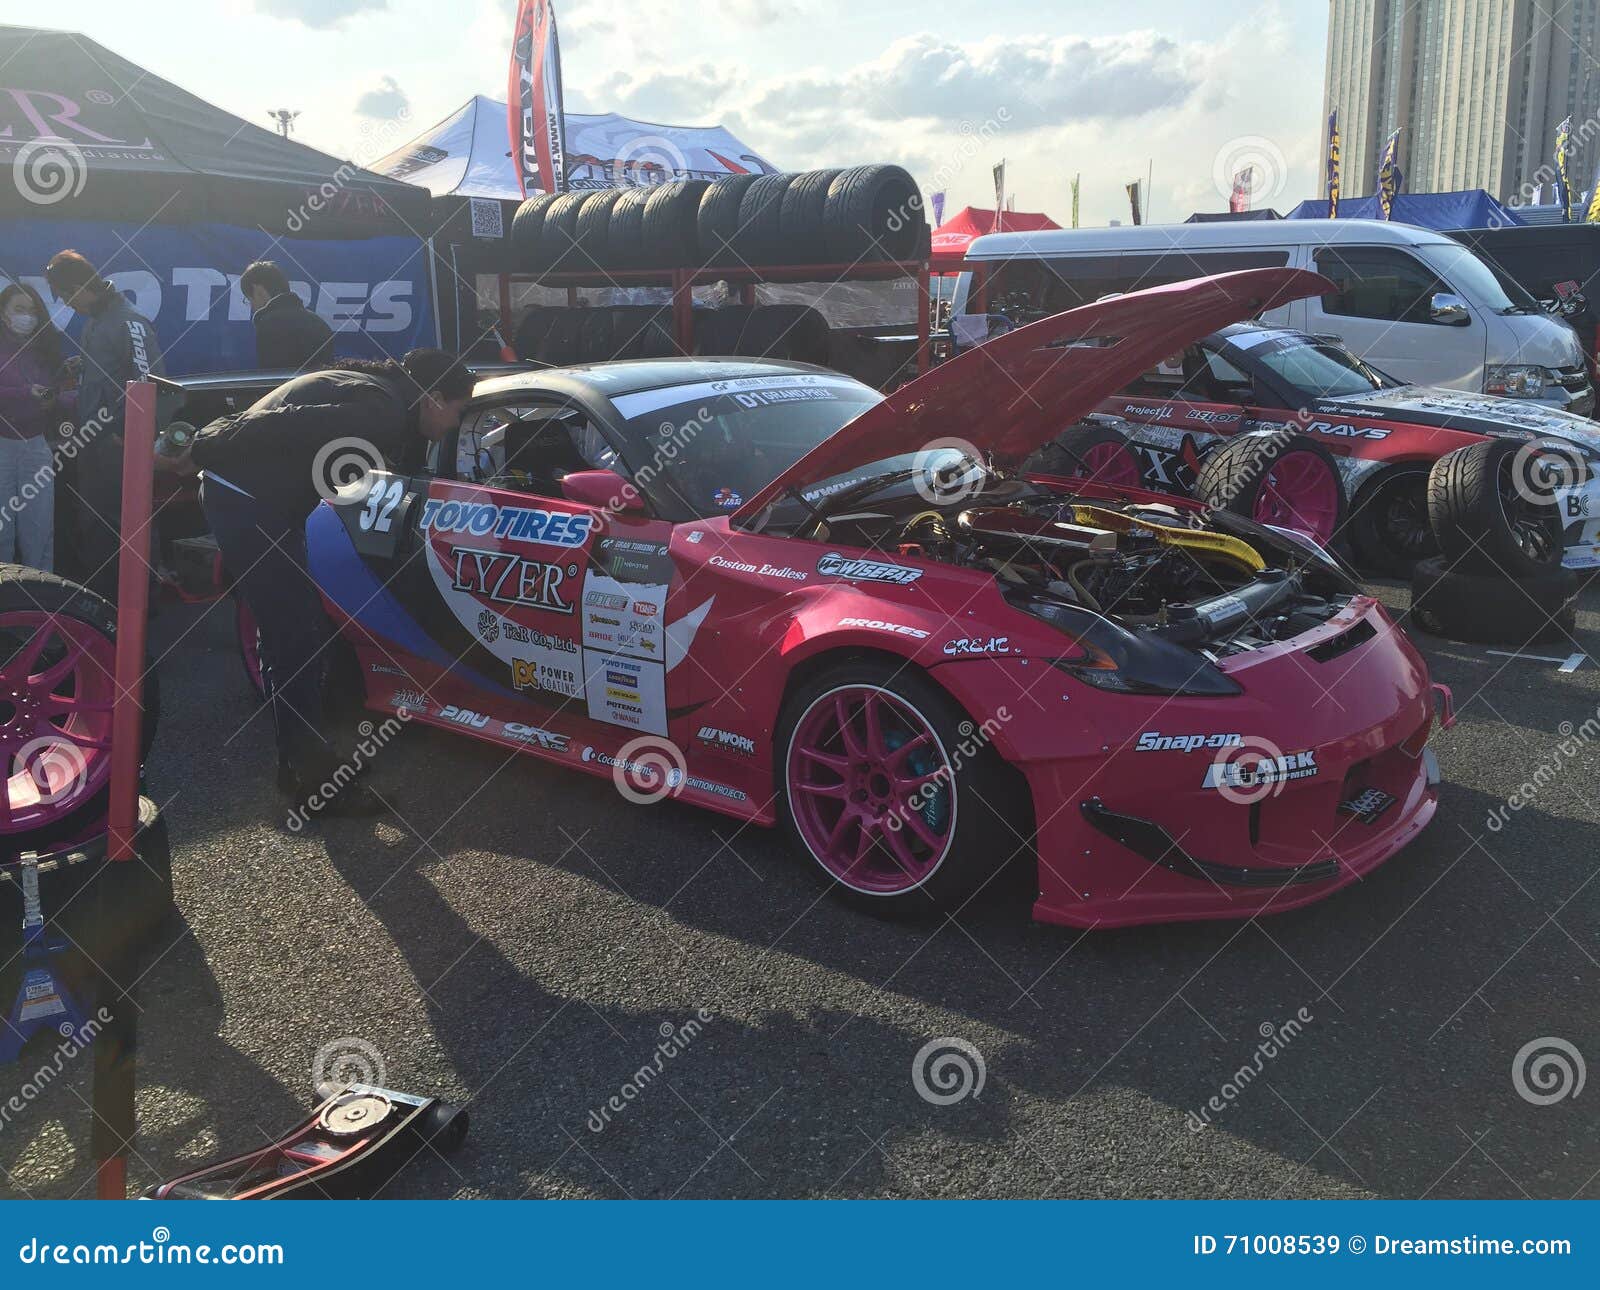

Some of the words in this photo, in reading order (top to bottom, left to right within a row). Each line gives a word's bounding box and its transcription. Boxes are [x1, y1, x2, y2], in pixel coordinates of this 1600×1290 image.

[1306, 421, 1392, 440] RAYS
[360, 479, 403, 532] 32
[708, 555, 757, 574] Custom
[759, 563, 808, 582] Endless
[837, 617, 931, 640] PROXES
[541, 665, 575, 683] POWER
[541, 678, 577, 695] COATING
[606, 700, 642, 714] POTENZA
[717, 730, 755, 753] WORK
[597, 751, 622, 767] Cocoa
[713, 783, 747, 801] PROJECTS
